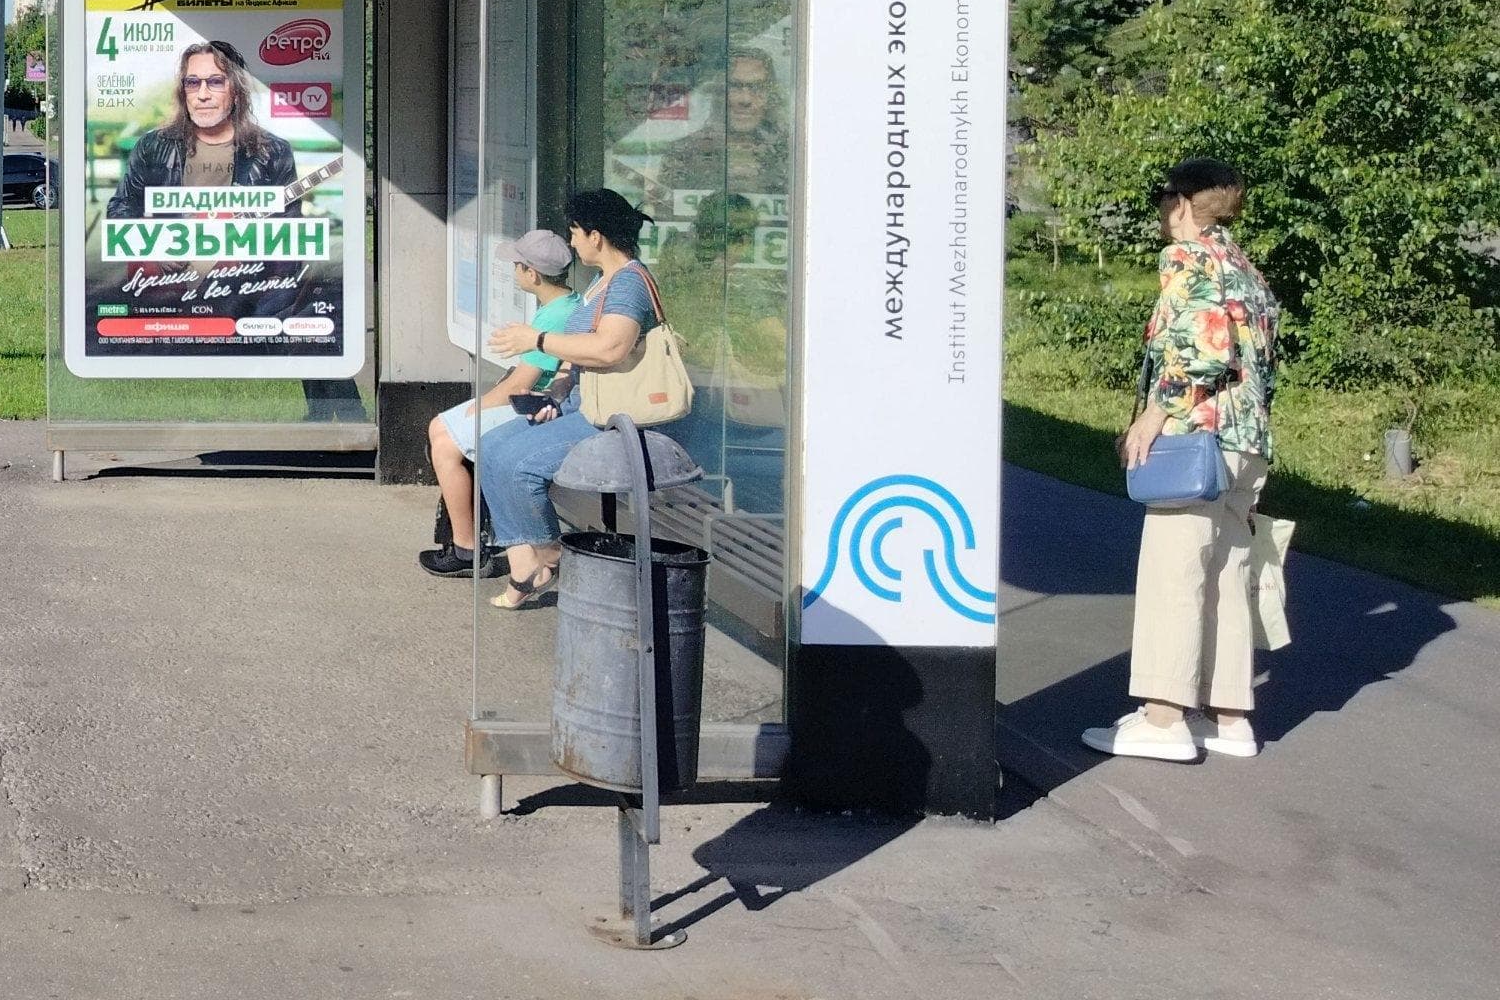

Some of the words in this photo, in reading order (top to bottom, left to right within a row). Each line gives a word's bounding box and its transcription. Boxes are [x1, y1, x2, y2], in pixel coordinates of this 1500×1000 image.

[177, 0, 233, 7] БИЛЕТЫ
[95, 17, 119, 61] 4
[124, 22, 174, 42] ИЮЛЯ
[311, 50, 331, 60] FM
[97, 73, 135, 88] ЗЕЛЁНЫЙ
[99, 88, 134, 96] ТЕАТР
[274, 91, 301, 106] RU
[307, 94, 323, 102] TV
[97, 97, 135, 108] ВДНХ
[152, 190, 276, 210] ВЛАДИМИР
[948, 90, 973, 296] Mezhdunarodnykh
[884, 64, 911, 340] международных
[106, 222, 324, 256] КУЗЬМИН
[122, 267, 199, 297] Лучшие
[207, 261, 265, 279] песни
[181, 288, 198, 301] и
[203, 280, 231, 300] все
[99, 305, 126, 314] metro
[191, 305, 214, 314] ICON
[312, 301, 335, 314] 12+
[243, 321, 275, 330] билеты
[948, 301, 966, 384] Institut
